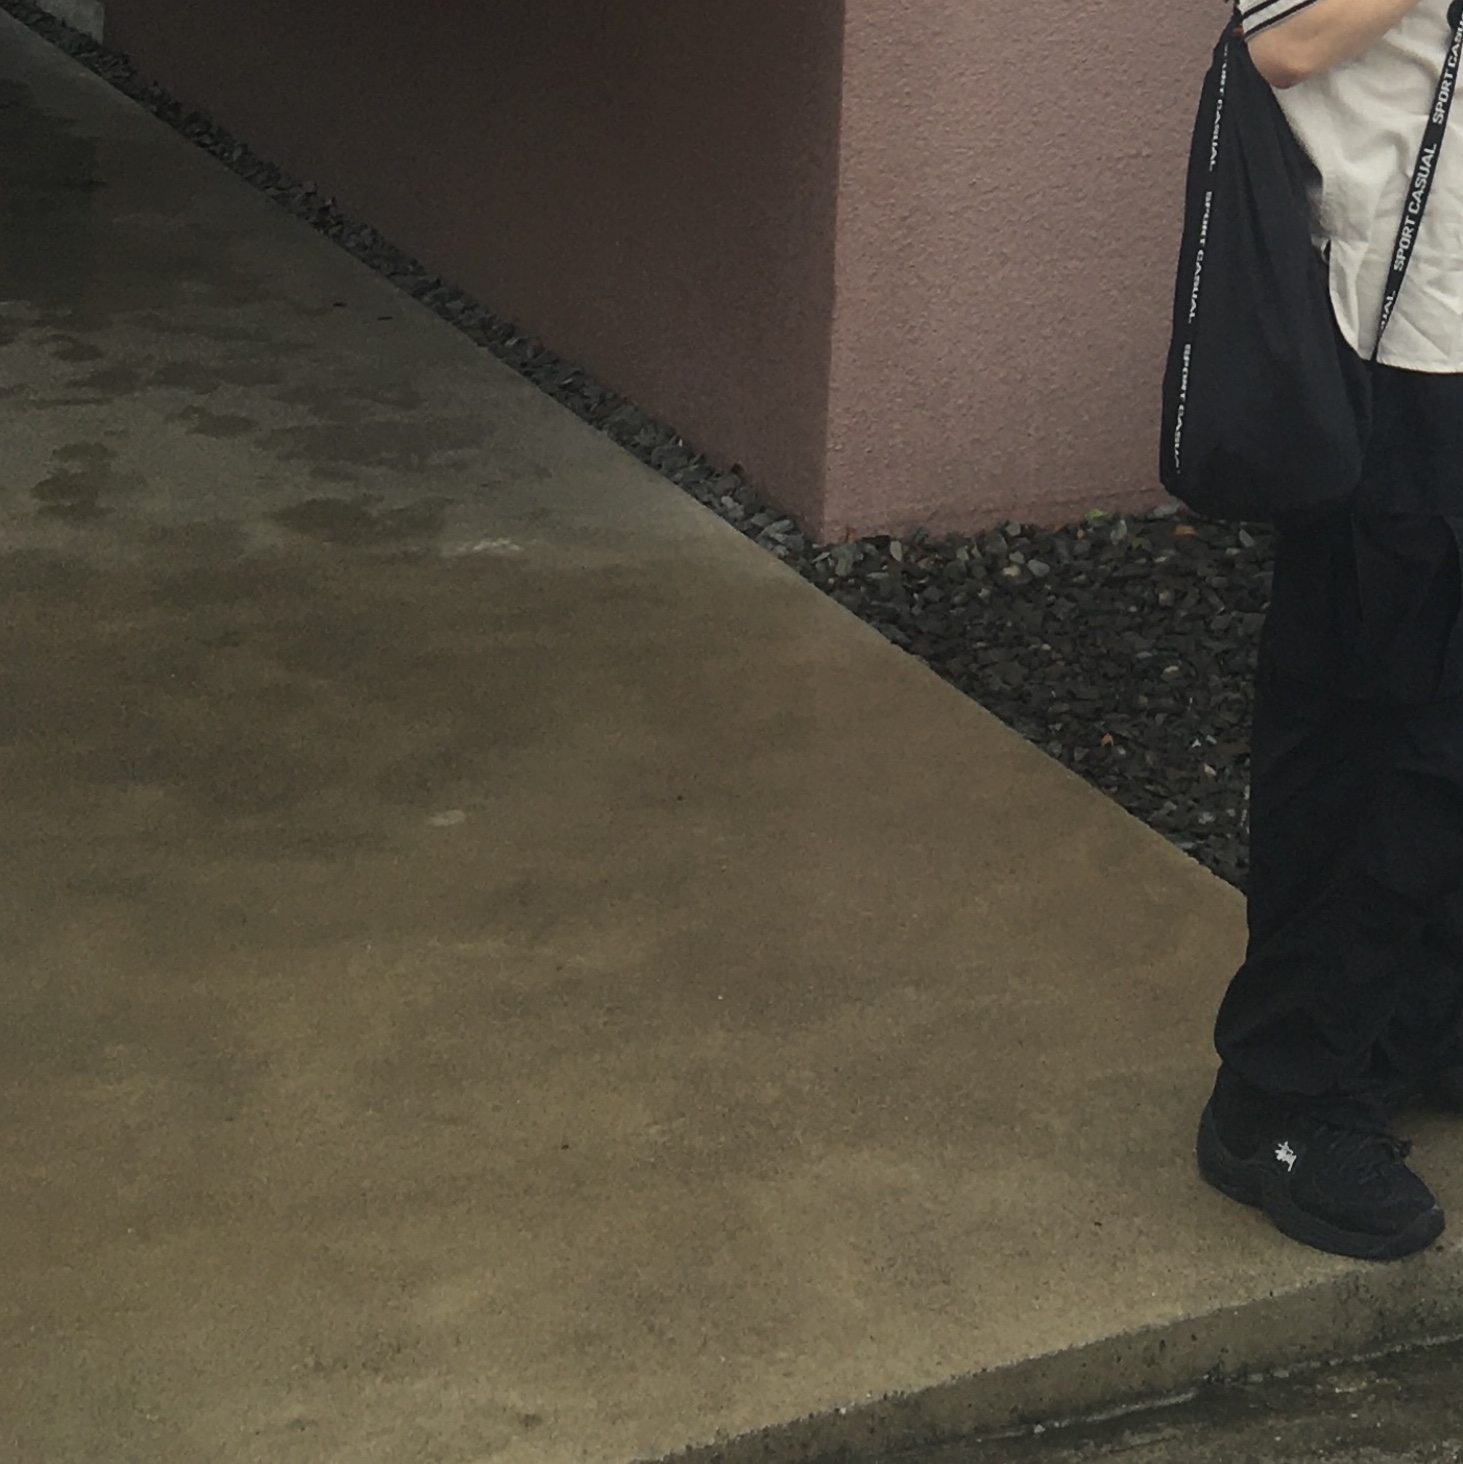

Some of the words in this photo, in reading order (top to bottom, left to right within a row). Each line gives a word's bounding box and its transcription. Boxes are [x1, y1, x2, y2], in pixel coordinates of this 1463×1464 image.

[1432, 68, 1456, 125] SPORT
[1393, 214, 1416, 271] SPORT
[1408, 143, 1438, 215] CASUAL
[1187, 249, 1205, 324] CASUAL
